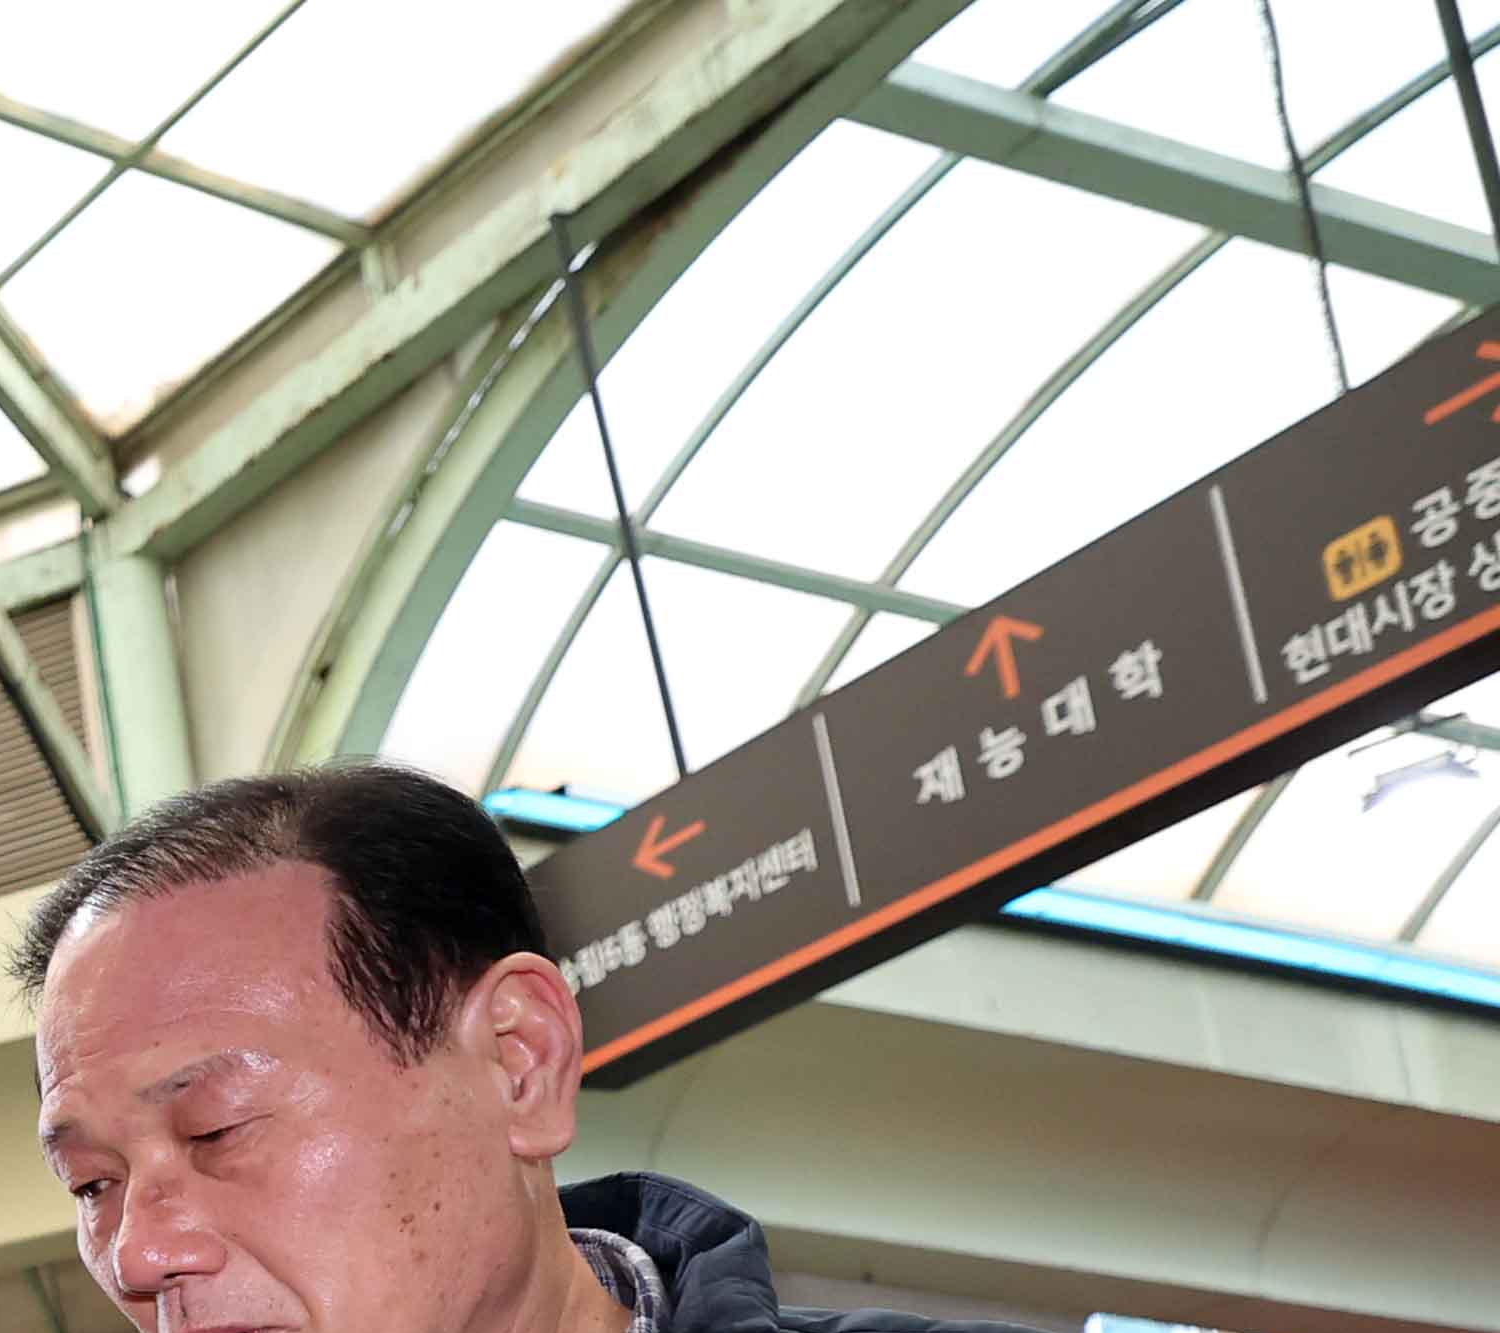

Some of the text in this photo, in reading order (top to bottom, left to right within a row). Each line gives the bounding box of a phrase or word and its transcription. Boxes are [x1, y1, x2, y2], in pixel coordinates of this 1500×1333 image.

[1281, 559, 1456, 684] 현대시장
[912, 641, 1164, 808] 재능대학
[645, 827, 819, 949] 행정복지센터
